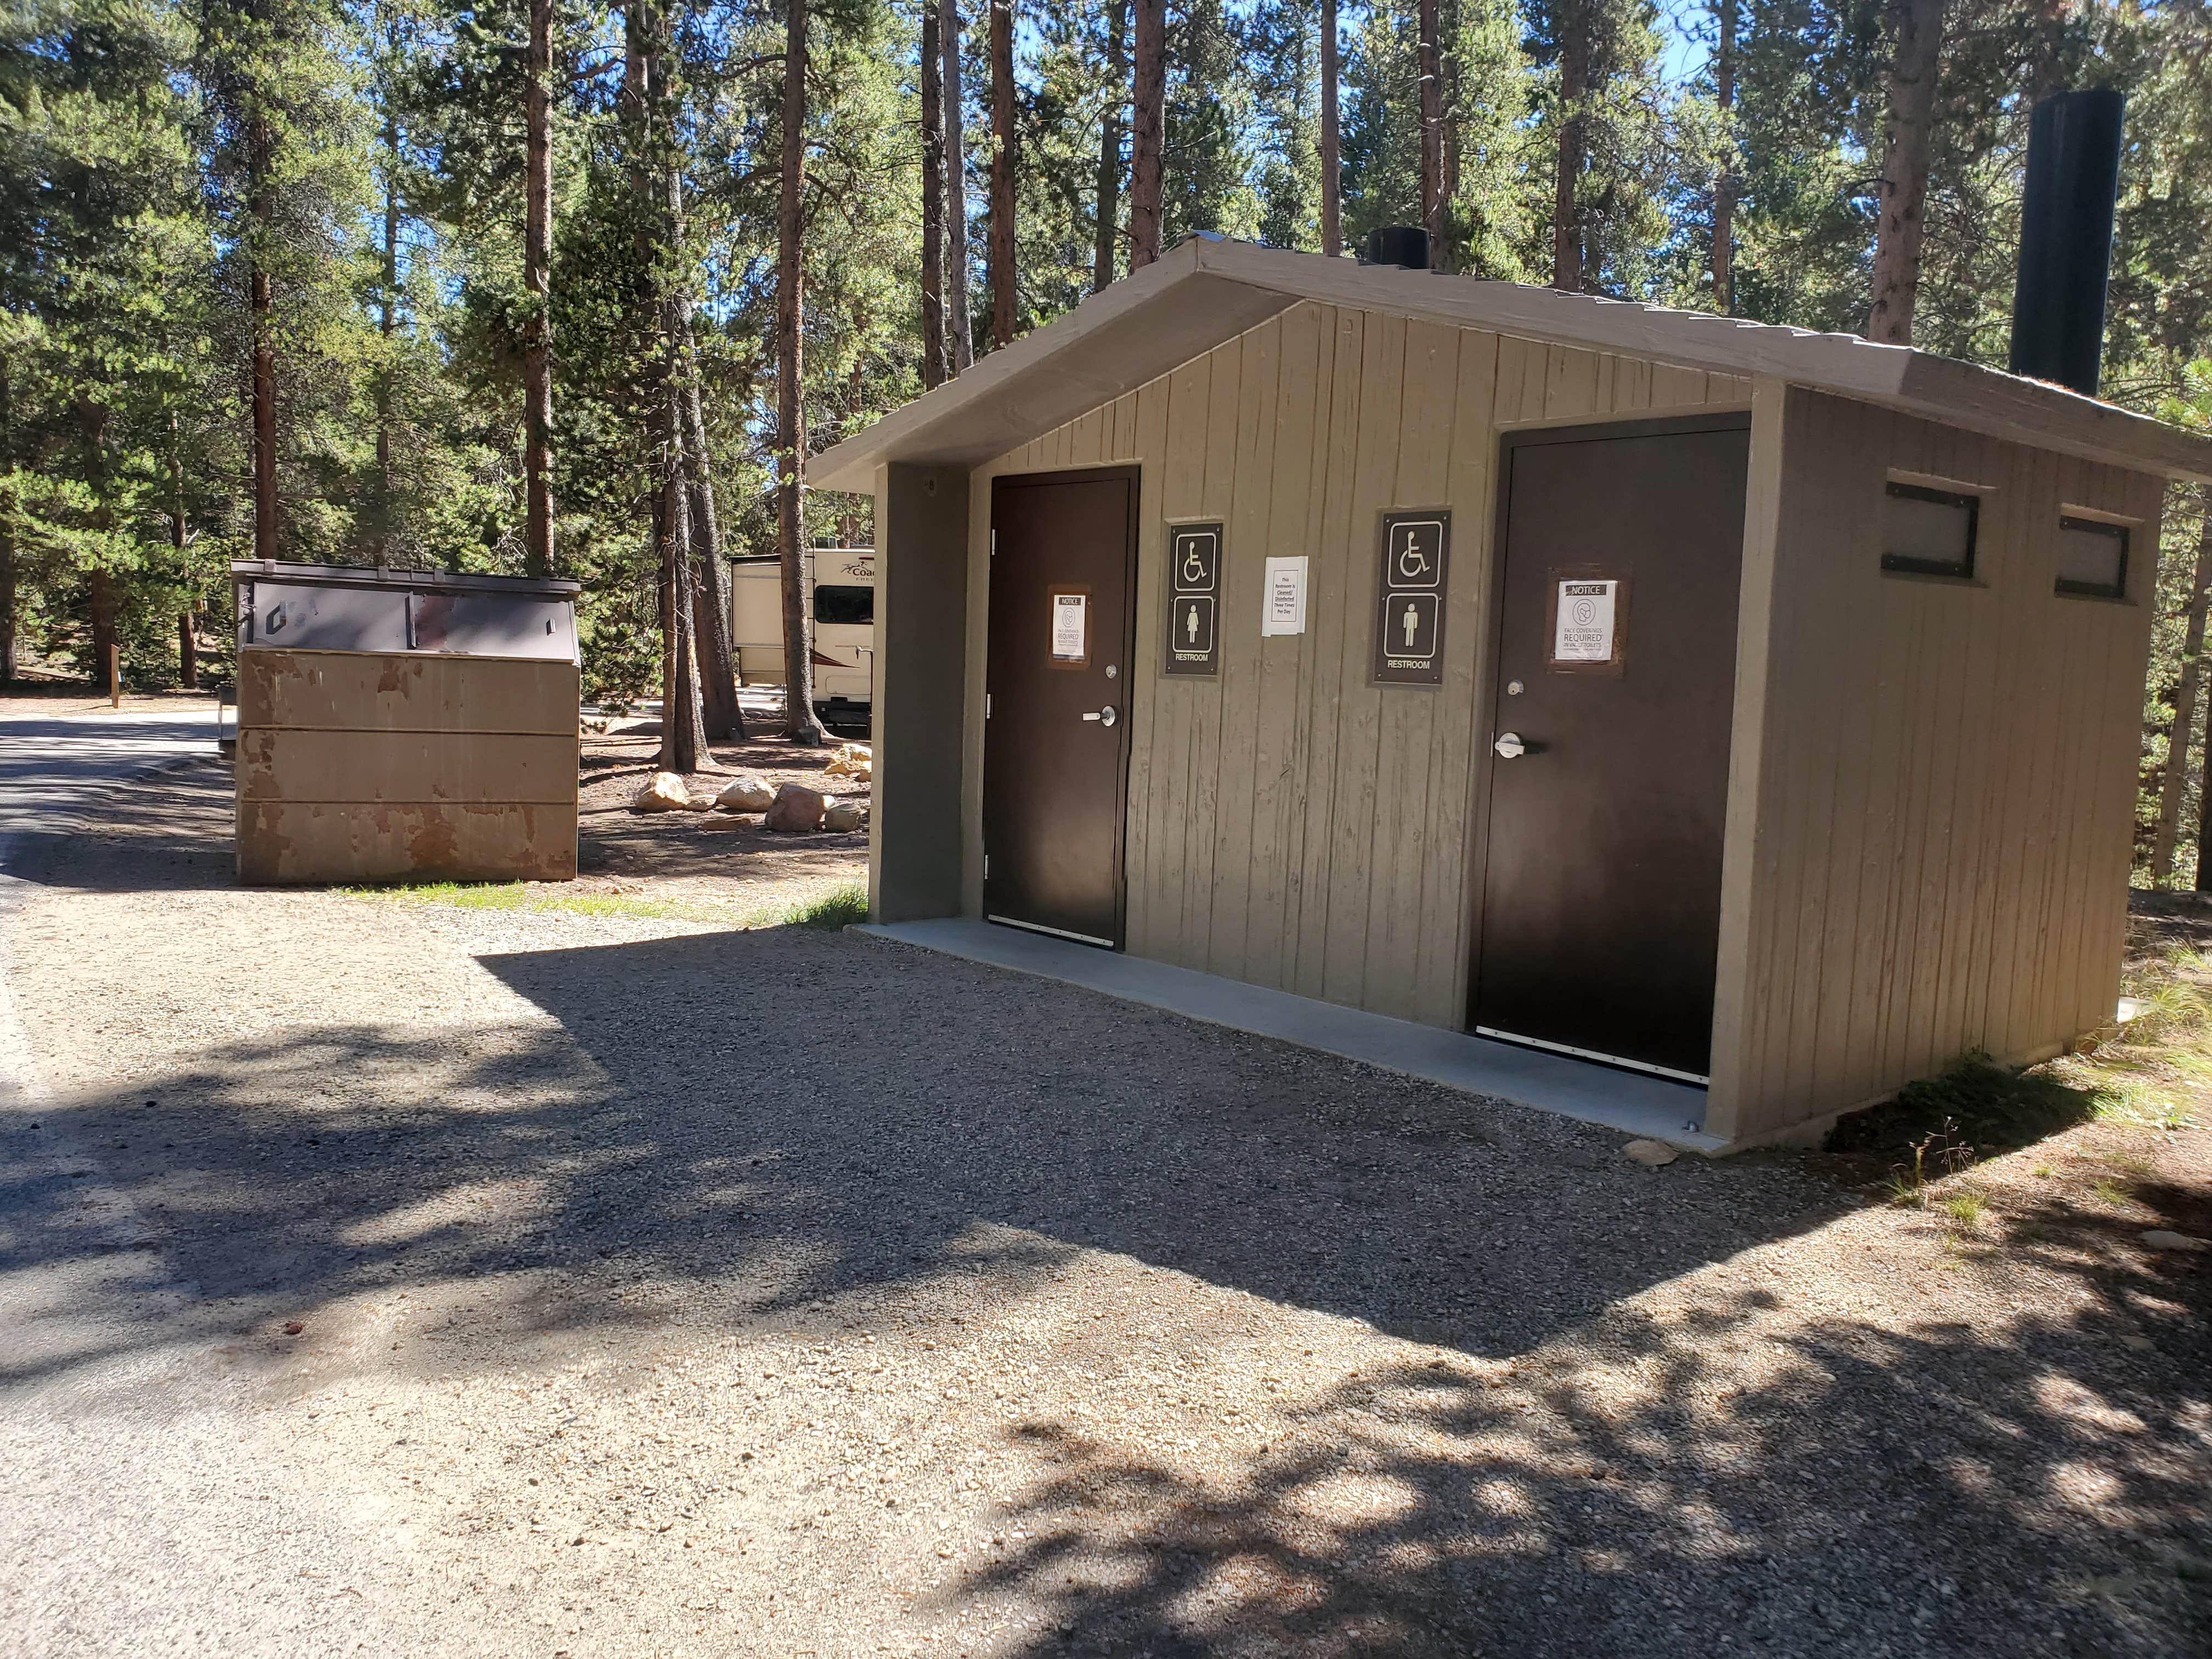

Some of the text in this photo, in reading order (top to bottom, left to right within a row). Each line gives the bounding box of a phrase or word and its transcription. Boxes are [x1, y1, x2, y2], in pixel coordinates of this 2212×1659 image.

[1572, 586, 1600, 594] NOTICE
[1564, 634, 1602, 642] REQUIRED
[1176, 653, 1208, 662] RESTROOM
[1387, 660, 1430, 669] RESTROOM
